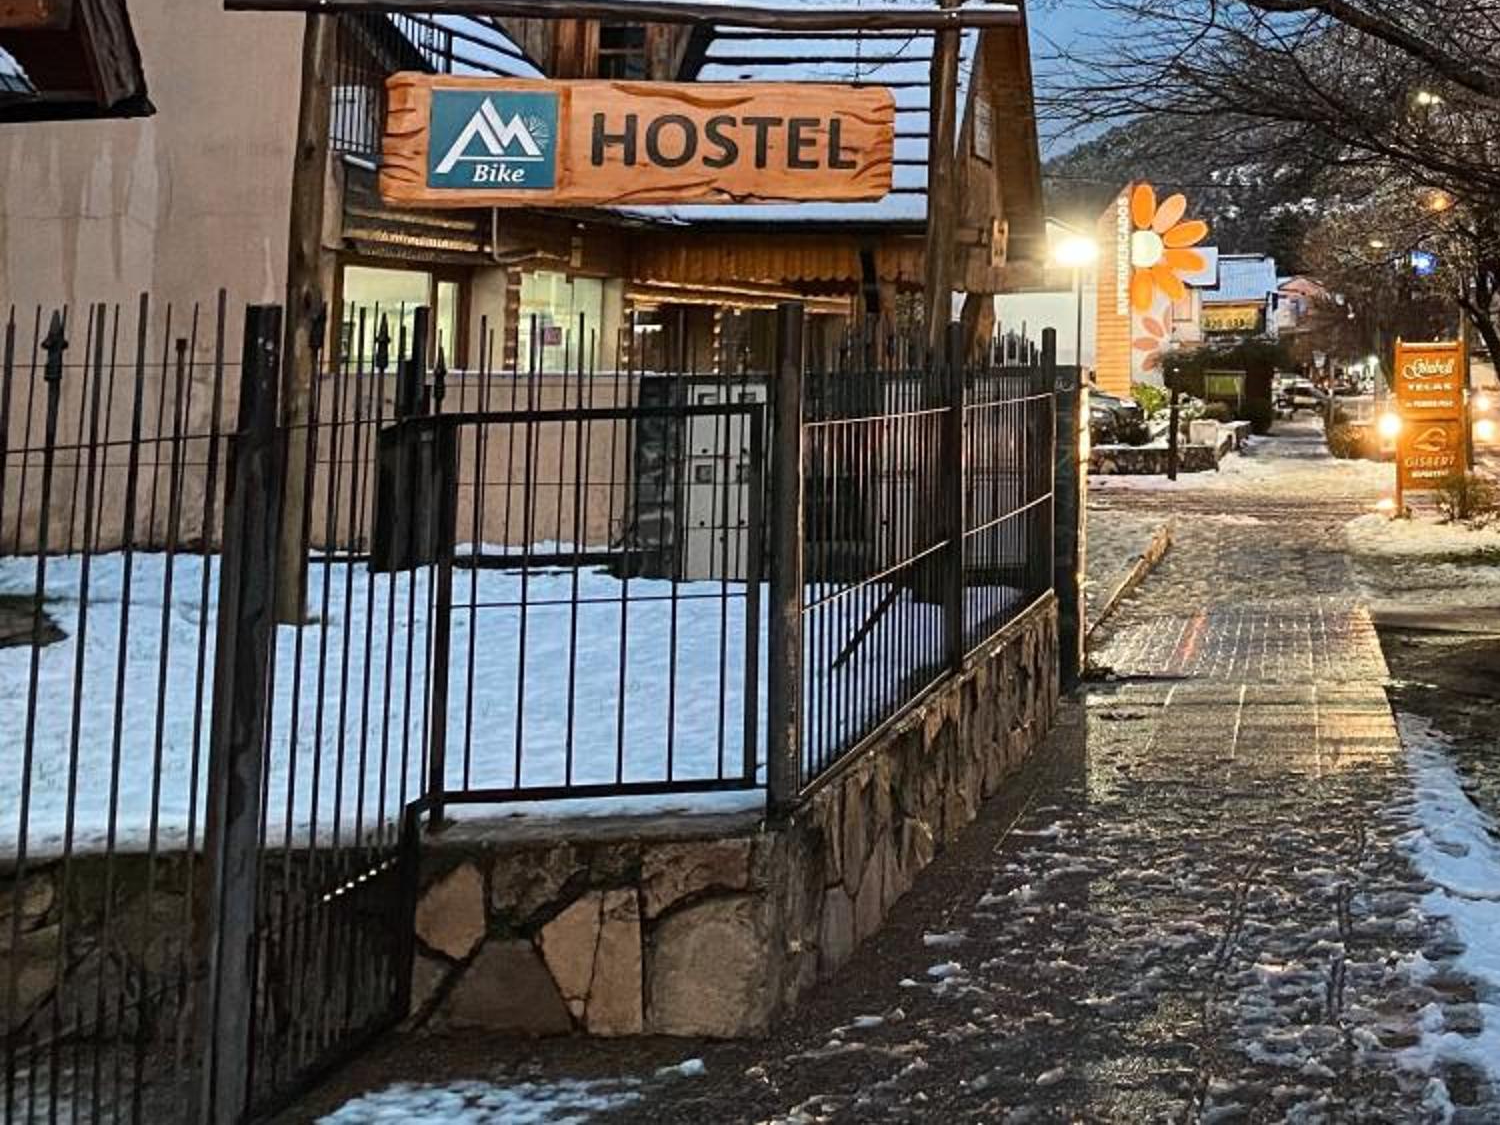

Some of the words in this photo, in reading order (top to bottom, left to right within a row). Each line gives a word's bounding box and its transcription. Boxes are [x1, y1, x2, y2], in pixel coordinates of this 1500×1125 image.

[592, 112, 858, 169] HOSTEL
[472, 161, 526, 183] Bike
[1117, 195, 1130, 316] SUPERMERCADOS
